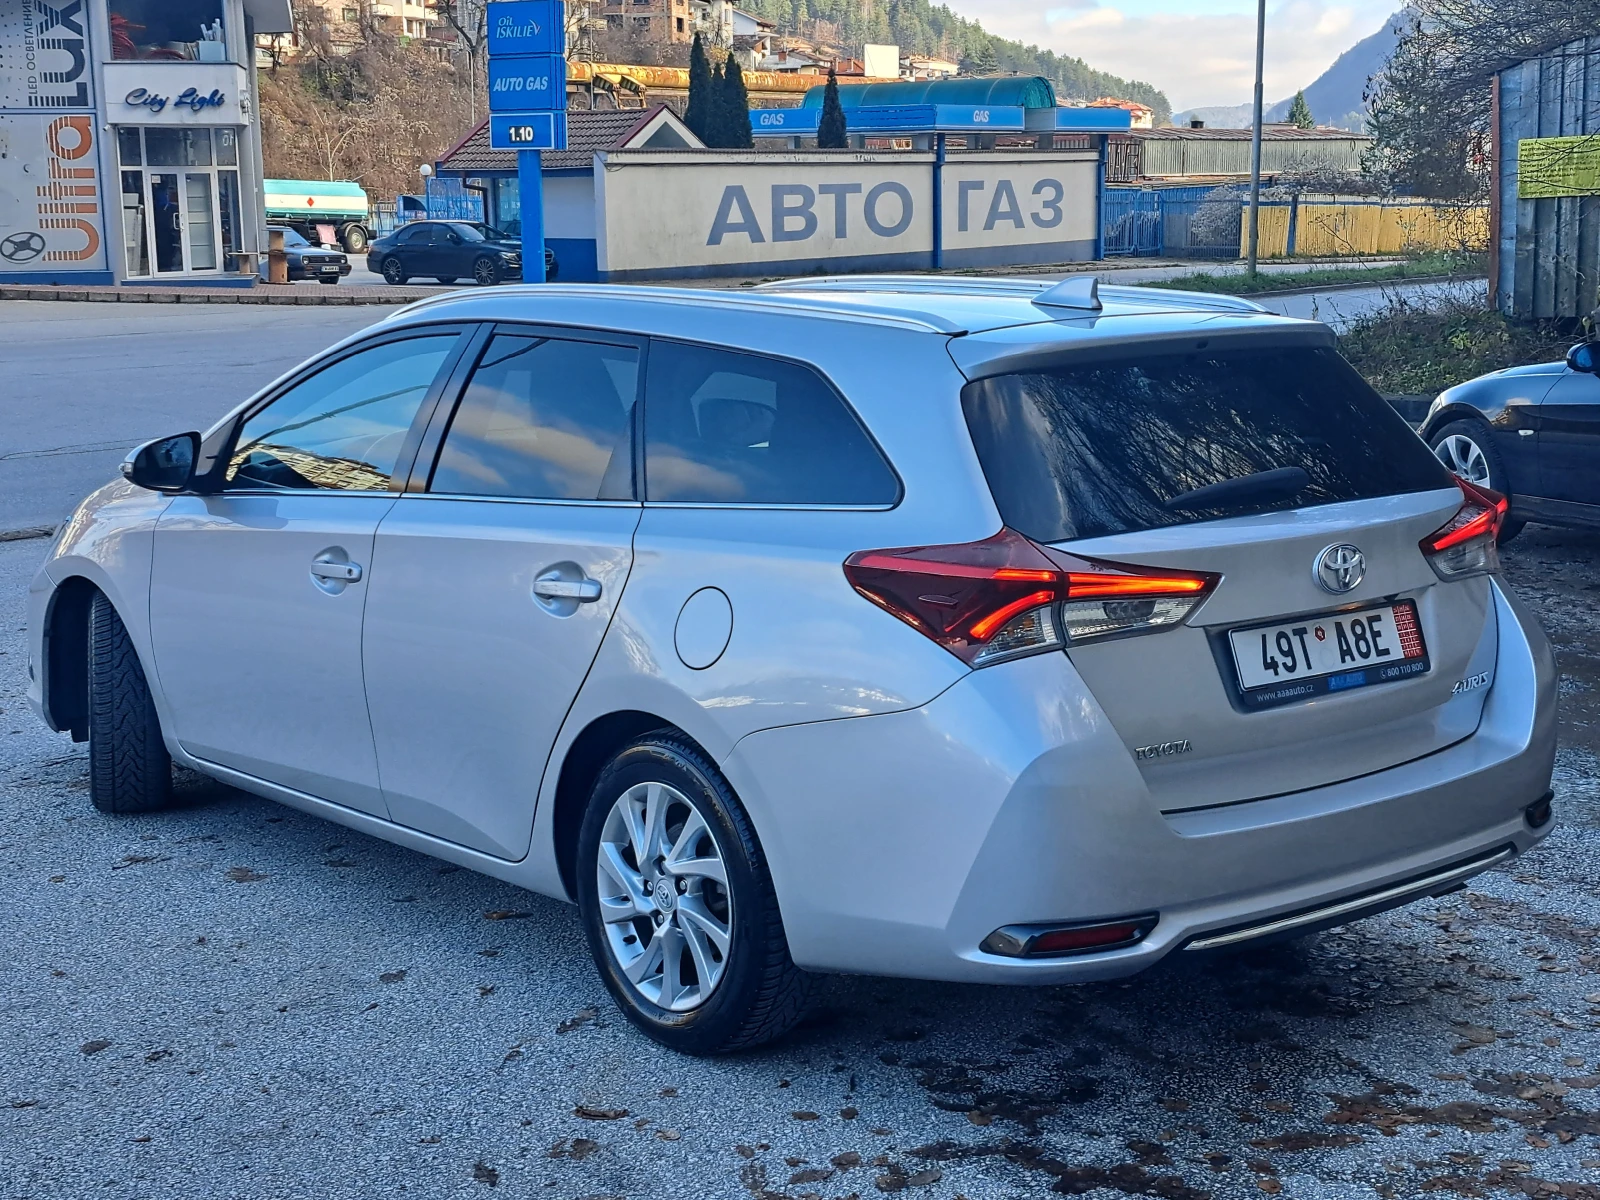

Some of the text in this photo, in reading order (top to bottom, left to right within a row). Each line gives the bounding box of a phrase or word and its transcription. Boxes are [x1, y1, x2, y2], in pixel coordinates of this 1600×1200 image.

[496, 19, 541, 38] ISKILIEV
[28, 76, 38, 95] LED
[493, 76, 548, 92] AUTO GAS
[125, 87, 226, 113] City Light
[760, 113, 785, 126] GAS
[973, 110, 990, 123] GAS
[509, 126, 534, 141] 1.10
[706, 178, 1064, 246] АВТО ГАЗ
[1261, 626, 1313, 677] 49T
[1334, 614, 1391, 664] A8E
[1387, 662, 1424, 677] 800 110 800
[1451, 671, 1489, 695] AURIS
[1257, 684, 1314, 702] www.aaaauto.cz
[1134, 739, 1193, 760] TOYOTA
